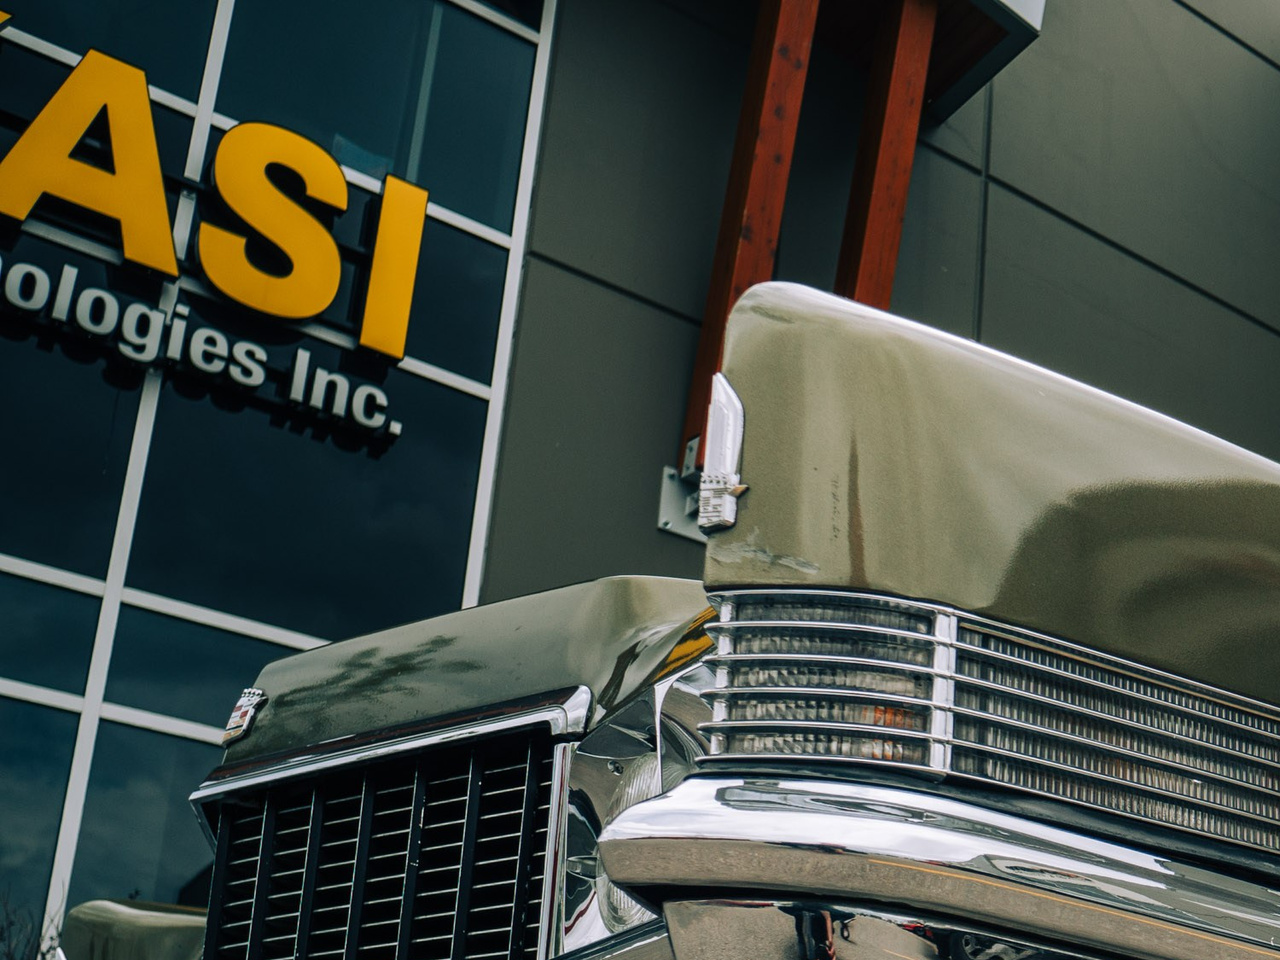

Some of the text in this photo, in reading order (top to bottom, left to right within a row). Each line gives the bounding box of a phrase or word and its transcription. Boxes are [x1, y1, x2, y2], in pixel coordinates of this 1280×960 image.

[0, 10, 428, 359] ASI
[0, 256, 402, 435] ologies Inc.
